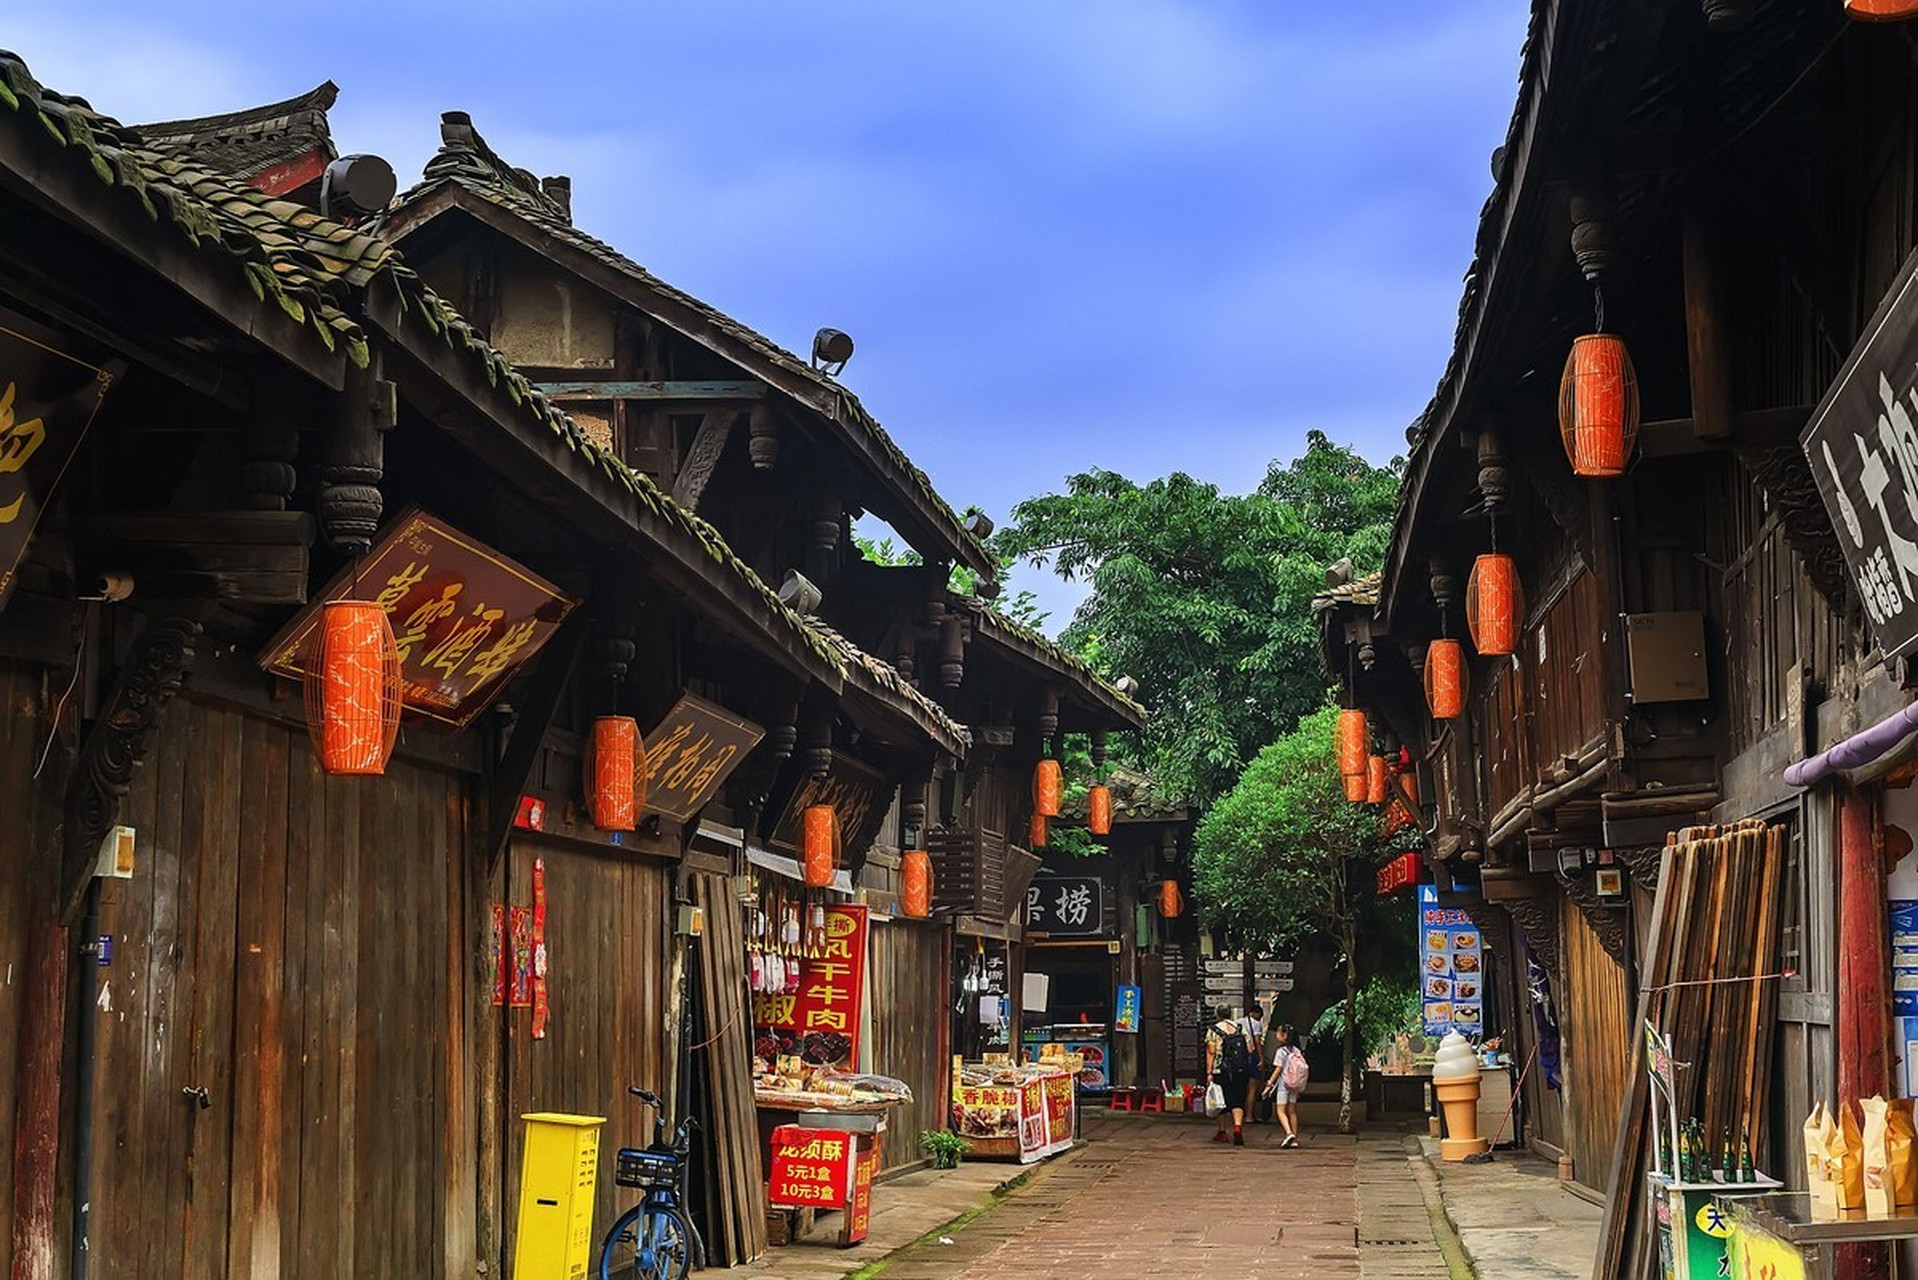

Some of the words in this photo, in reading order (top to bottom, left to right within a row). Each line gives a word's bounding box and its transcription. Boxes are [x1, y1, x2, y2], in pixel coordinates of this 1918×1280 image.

[828, 917, 851, 933] 撕
[786, 1164, 832, 1182] 5元1盒
[780, 1183, 835, 1201] 10元3盒
